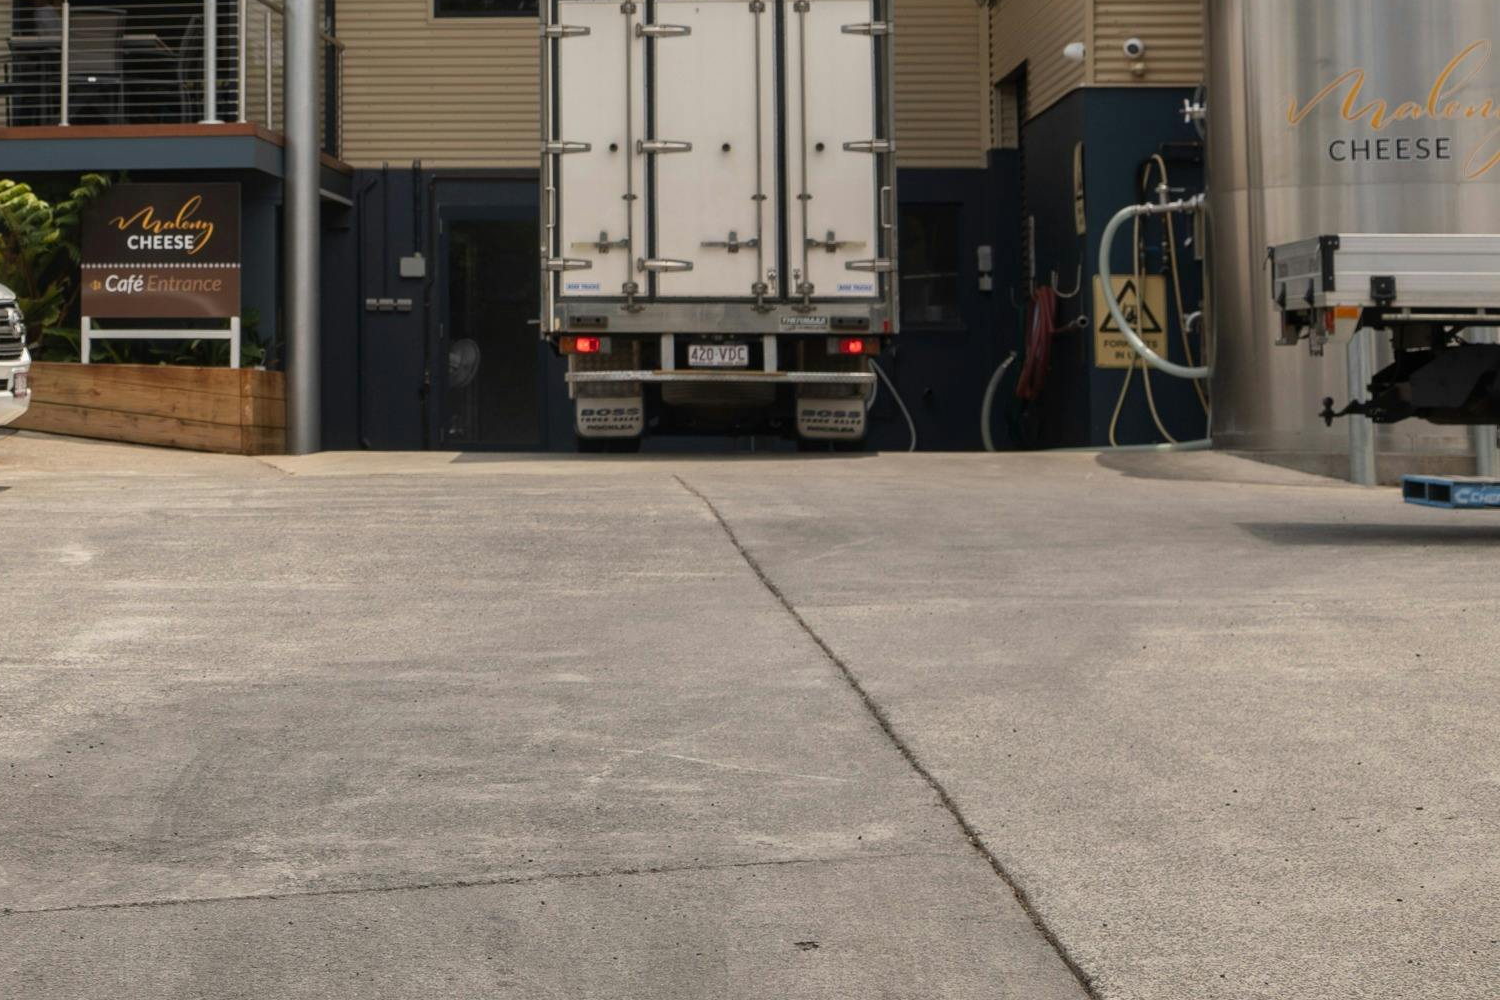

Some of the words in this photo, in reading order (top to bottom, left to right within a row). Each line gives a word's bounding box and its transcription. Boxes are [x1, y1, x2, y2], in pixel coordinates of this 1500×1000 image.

[1329, 138, 1451, 161] CHEESE
[108, 195, 214, 255] Maleny
[127, 235, 194, 250] CHEESE
[105, 274, 144, 294] Café
[147, 275, 222, 291] Entrance
[581, 408, 640, 416] BOSS
